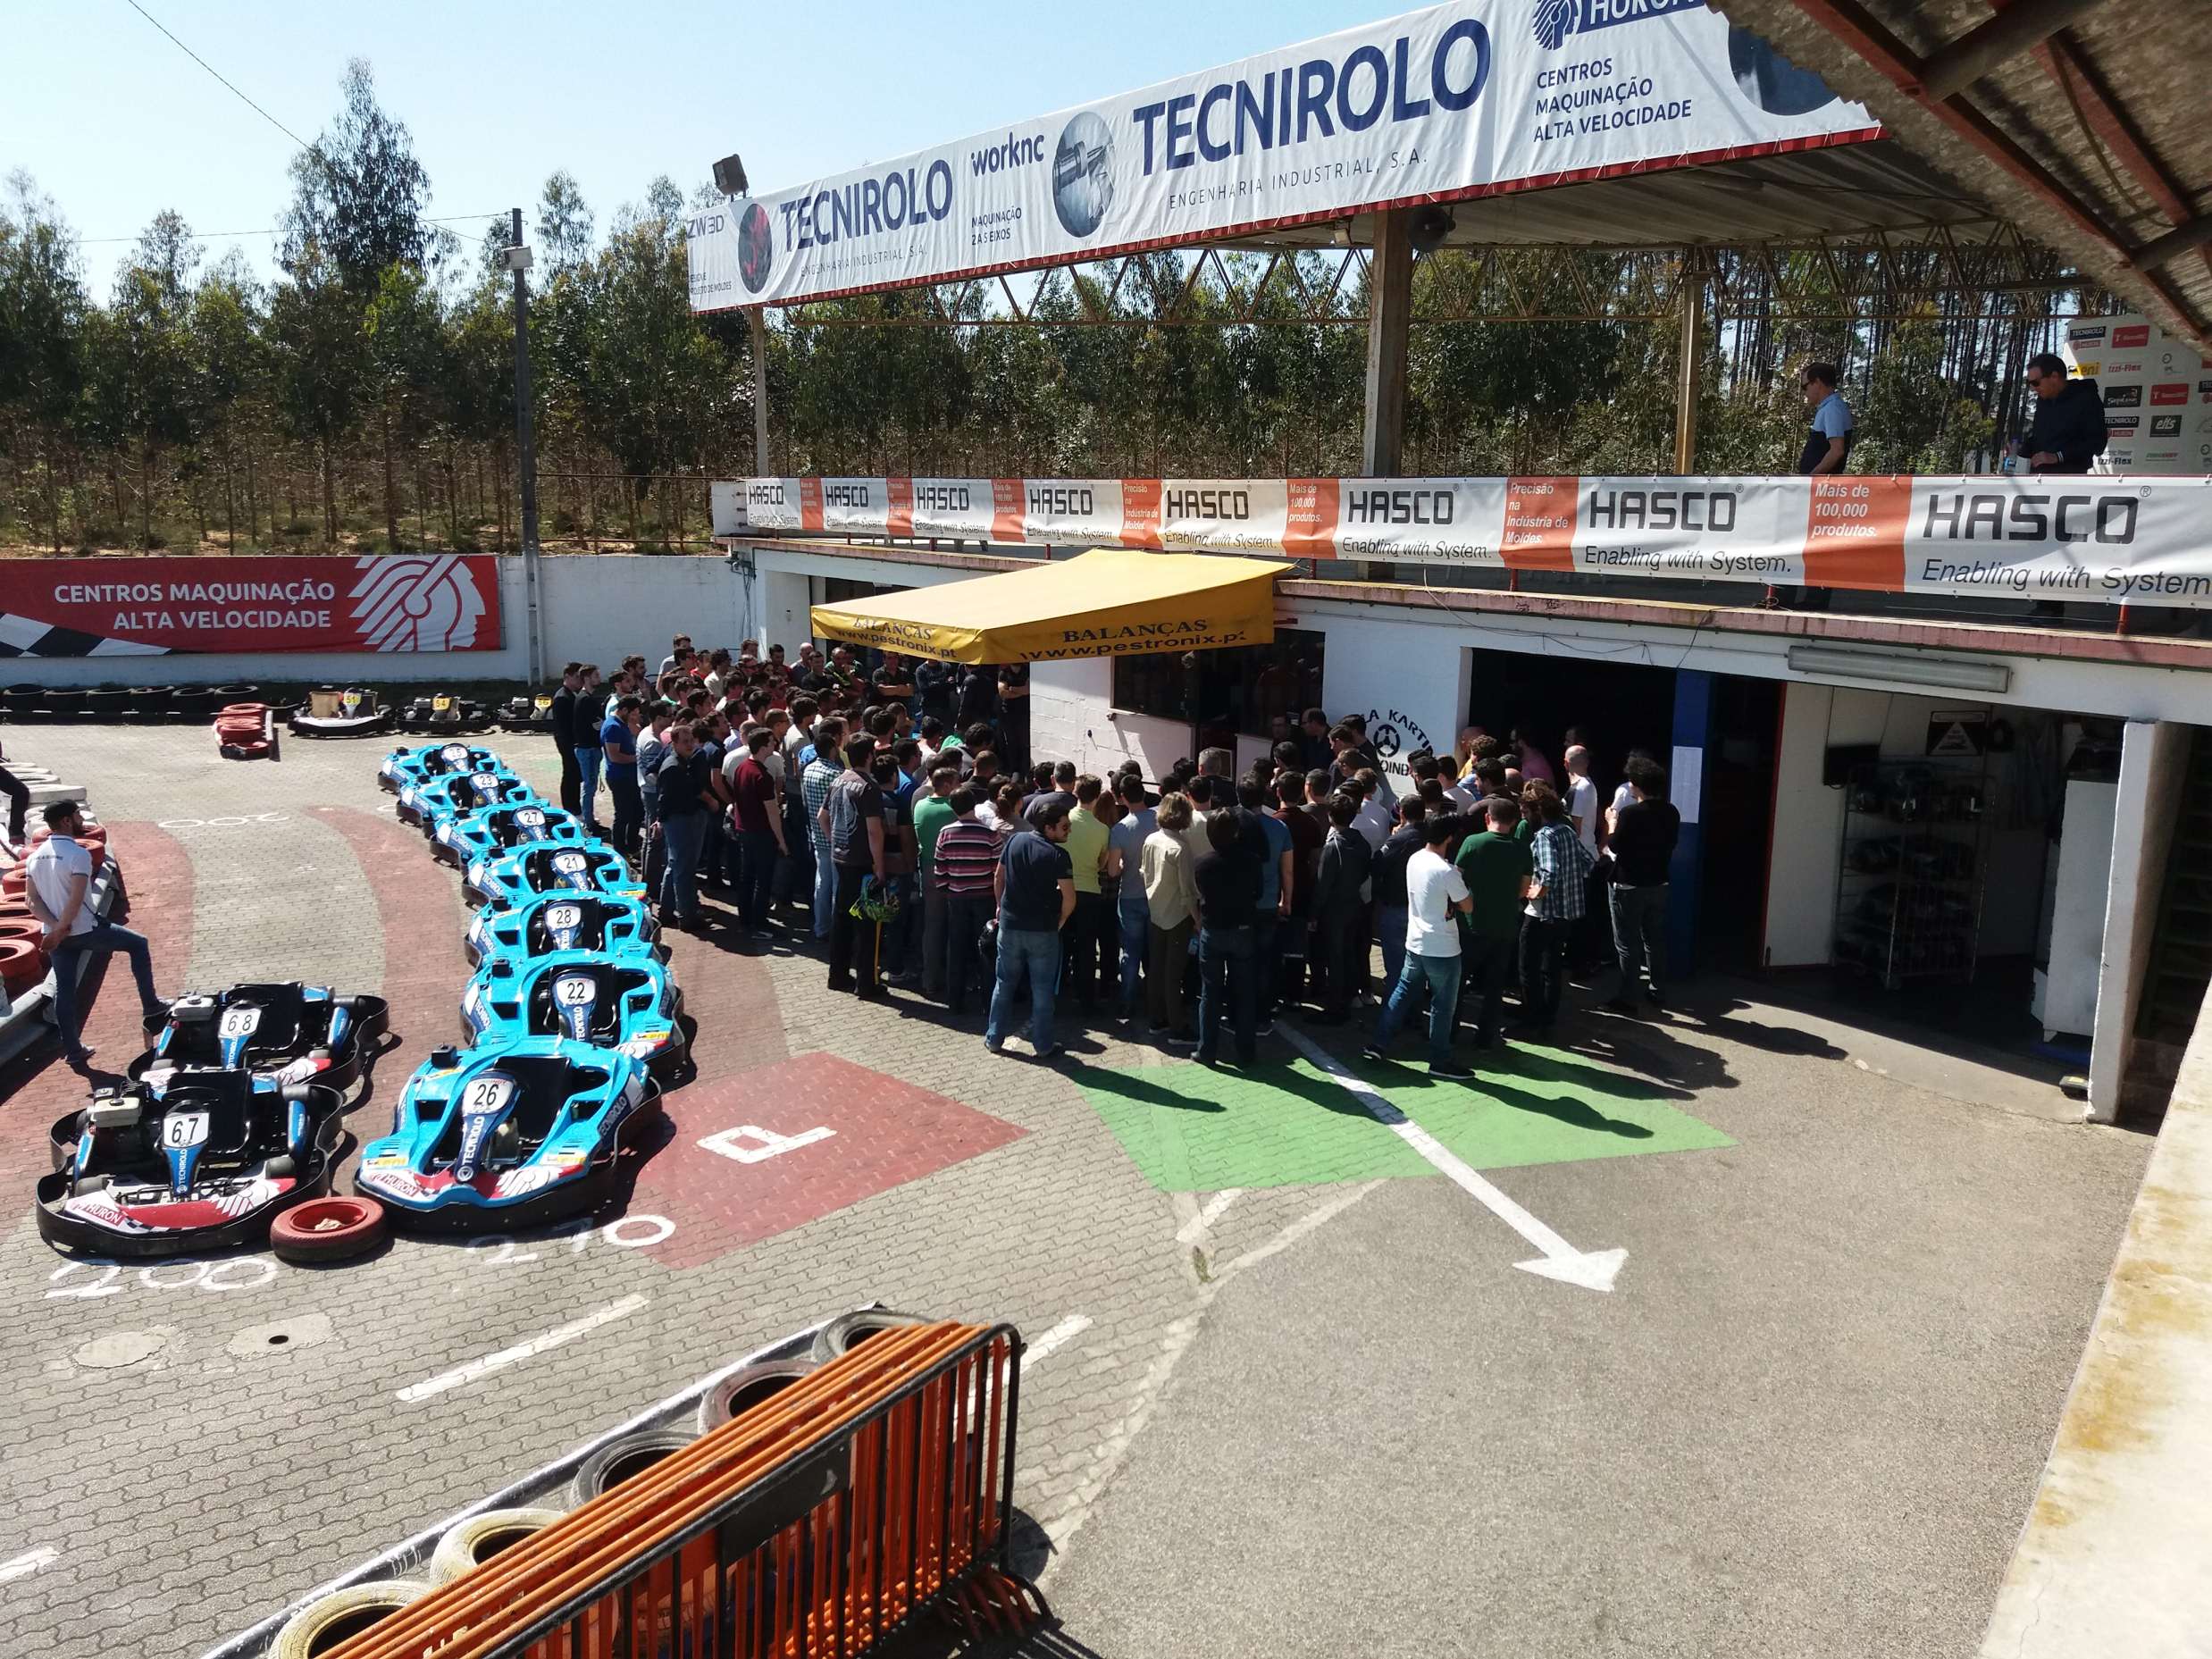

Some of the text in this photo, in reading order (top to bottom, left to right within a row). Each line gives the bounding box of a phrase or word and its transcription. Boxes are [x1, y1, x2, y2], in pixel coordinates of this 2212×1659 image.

[1537, 57, 1613, 88] CENTROS
[1133, 19, 1491, 176] TECNIROLO
[1535, 76, 1653, 115] MAQUINAÇÃO
[1533, 99, 1692, 142] ALTA VELOCIDADE
[971, 131, 1044, 177] worknc
[1169, 178, 1263, 210] ENGENHARIA
[1391, 148, 1428, 169] S.A.
[780, 159, 953, 252] TECNIROLO
[971, 205, 1022, 228] MAQUINAÇÃO
[971, 234, 976, 246] 2
[977, 233, 983, 244] A
[989, 228, 1011, 242] EIXOS
[749, 485, 783, 506] HASCO
[825, 486, 868, 507] HASCO
[917, 487, 969, 511] HASCO
[1123, 483, 1148, 493] Precisão
[1289, 483, 1316, 493] Mais de
[1510, 482, 1554, 495] Precisão
[1814, 483, 1870, 498] Mais de
[1030, 489, 1093, 515] HASCO
[1167, 490, 1249, 520] HASCO
[1291, 498, 1316, 508] 100,000
[1348, 490, 1454, 525] HASCO
[1508, 501, 1521, 511] na
[1588, 491, 1737, 532] HASCO
[1814, 503, 1868, 519] 100,000
[1152, 510, 1158, 518] de
[1289, 513, 1322, 524] produtos.
[1507, 515, 1568, 529] Indústria de
[1923, 494, 2139, 545] HASCO
[1166, 532, 1208, 546] Enabling
[1211, 534, 1232, 546] with
[1505, 532, 1543, 544] Moldes.
[1811, 524, 1878, 540] produtos.
[1343, 537, 1492, 559] Enabling with System.
[1585, 546, 1791, 574] Enabling with System.
[1923, 558, 2212, 596] Enabling with System
[54, 578, 335, 605] CENTROS MAQUINAÇÃO
[113, 610, 331, 630] ALTA VELOCIDADE
[1062, 618, 1208, 642] BALANÇAS
[480, 775, 492, 785] 23
[524, 812, 538, 824] 27
[565, 857, 579, 871] 21
[556, 909, 572, 925] 28
[567, 983, 585, 1001] 22
[227, 1014, 253, 1032] 68
[473, 1084, 499, 1106] 26
[172, 1118, 199, 1144] 67
[381, 1173, 418, 1196] HURON
[85, 1202, 123, 1225] HURON
[44, 1257, 279, 1299] 200
